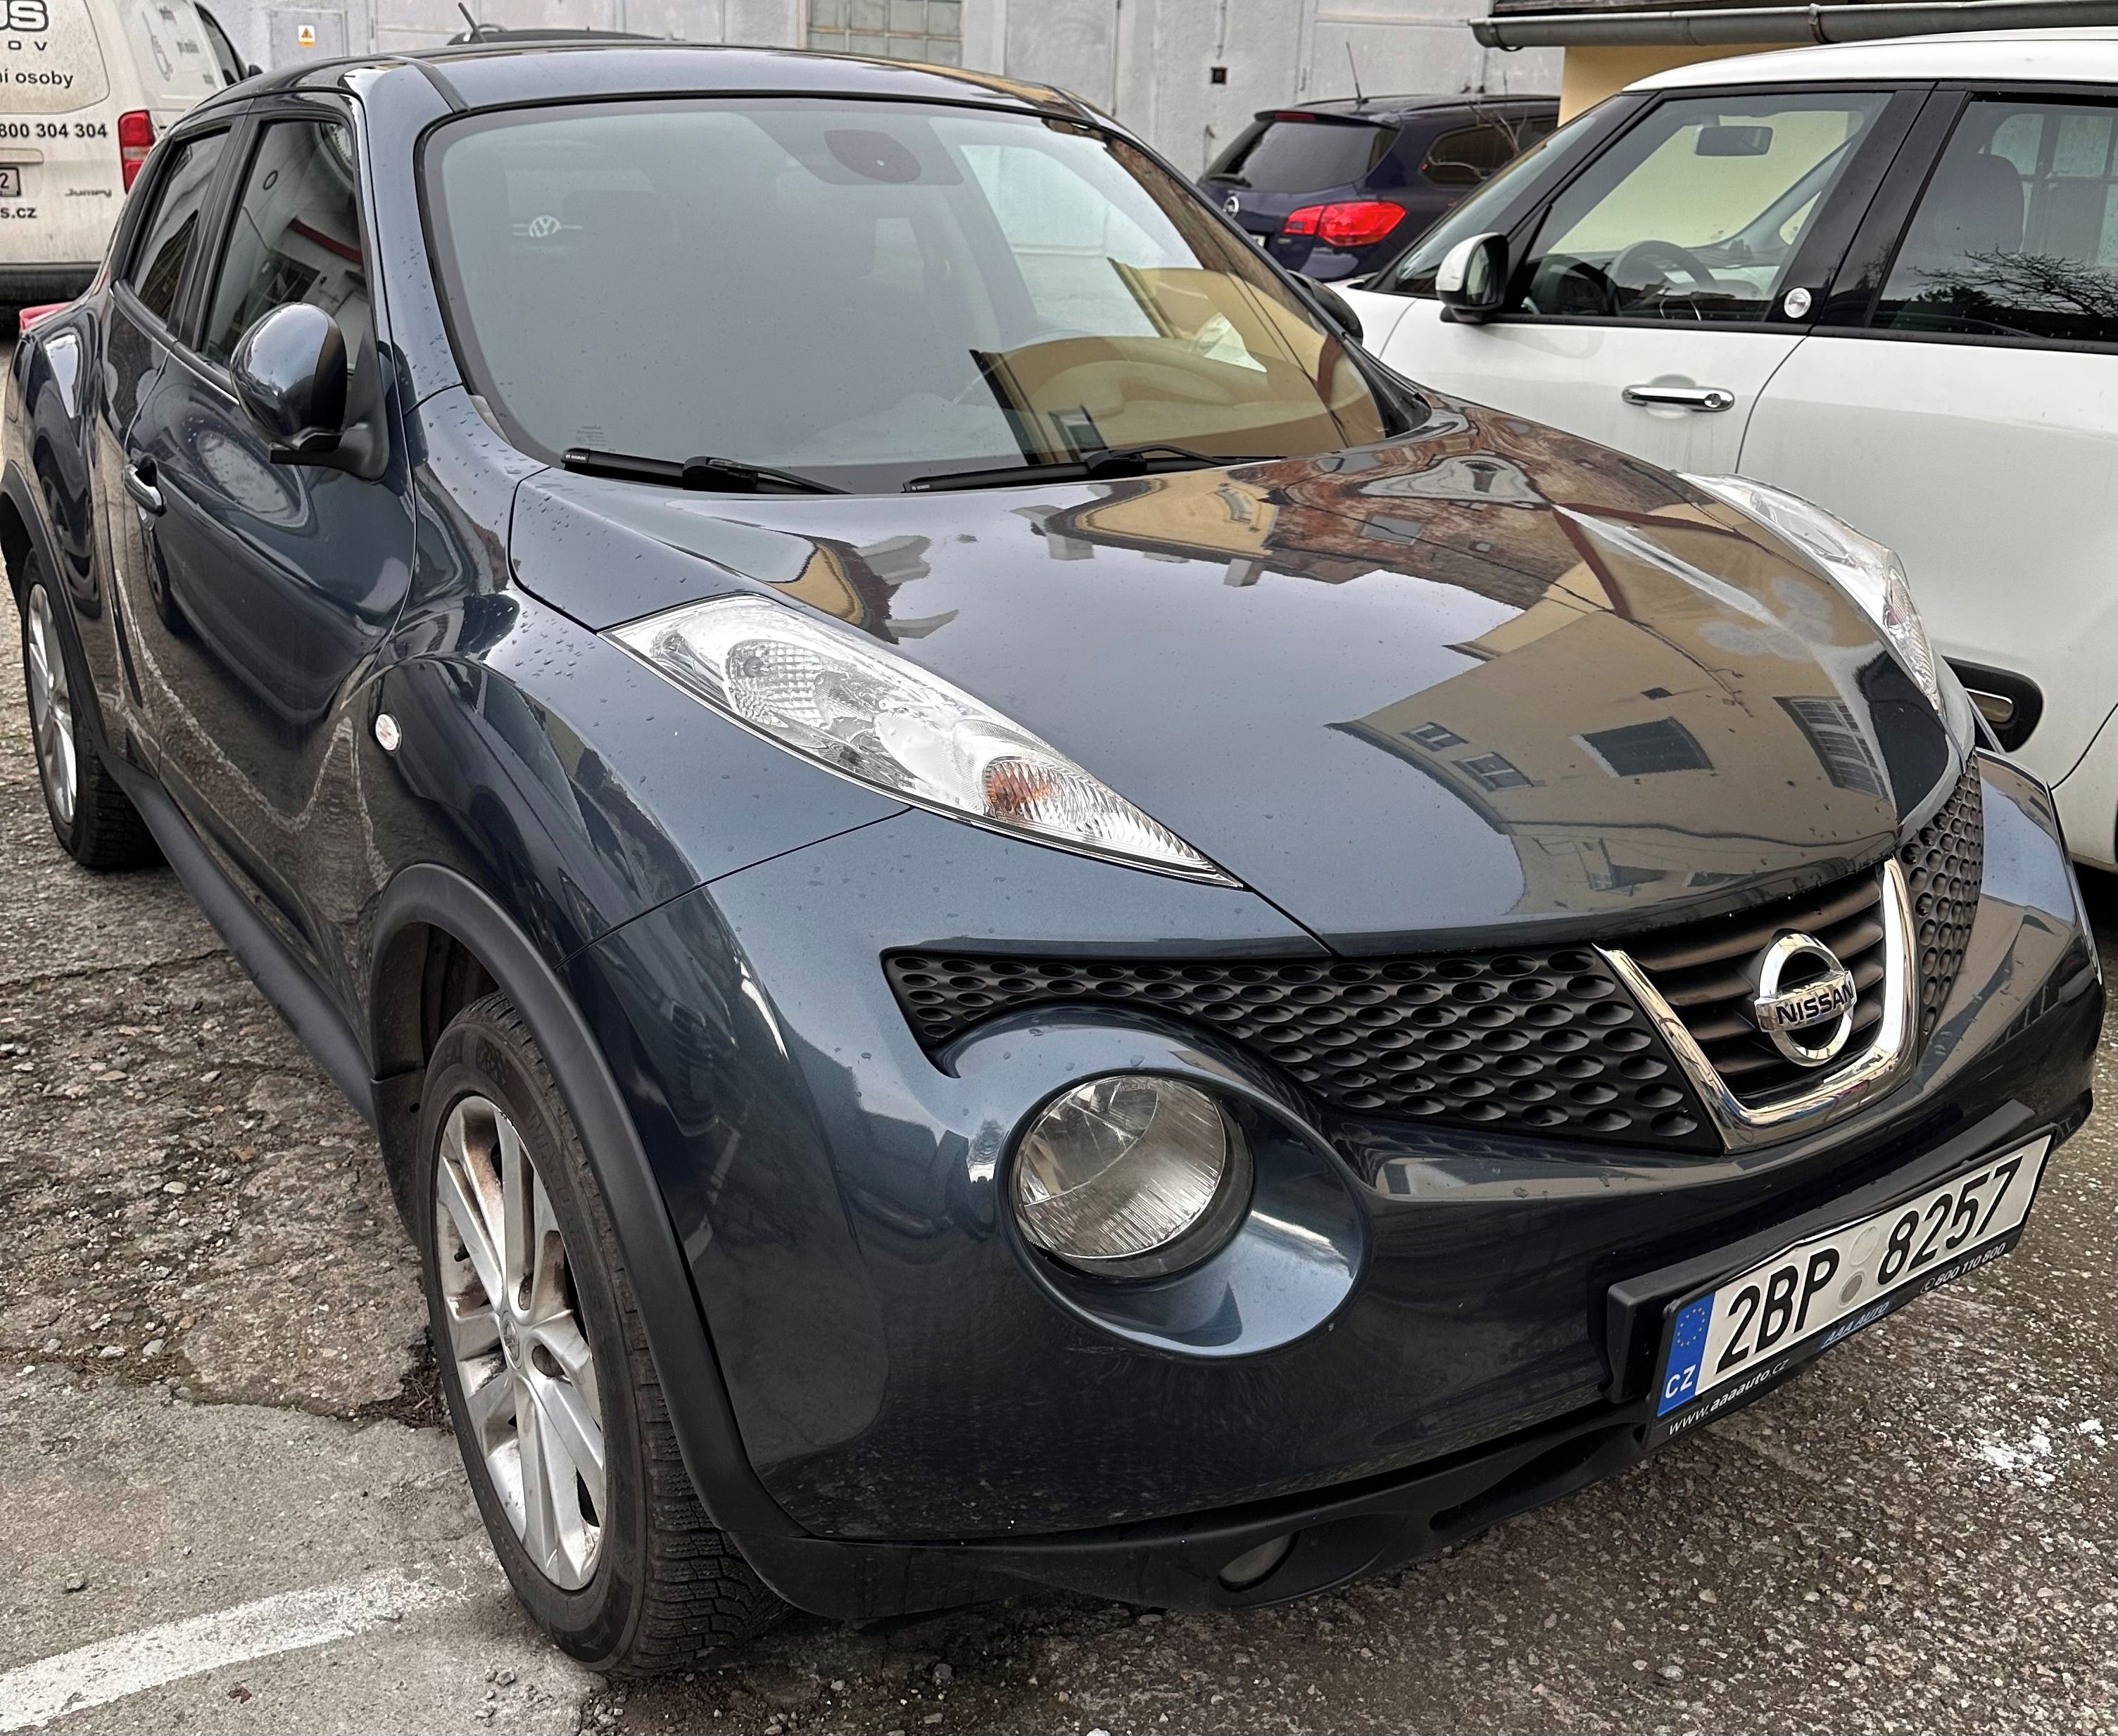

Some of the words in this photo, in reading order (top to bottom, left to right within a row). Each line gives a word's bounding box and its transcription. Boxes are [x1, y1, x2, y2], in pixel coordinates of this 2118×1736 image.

[15, 70, 73, 89] osoby
[0, 123, 30, 138] 800
[36, 123, 68, 138] 304
[75, 123, 107, 138] 304
[1776, 980, 1855, 1024] NISSAN
[1716, 1248, 1840, 1374] 2BP
[1877, 1155, 2023, 1286] 8257
[1934, 1266, 1960, 1286] 800
[1961, 1255, 1982, 1273] 110
[1981, 1242, 2006, 1263] 800
[1665, 1364, 1696, 1399] CZ
[1668, 1358, 1790, 1436] www.aaaauto.cz
